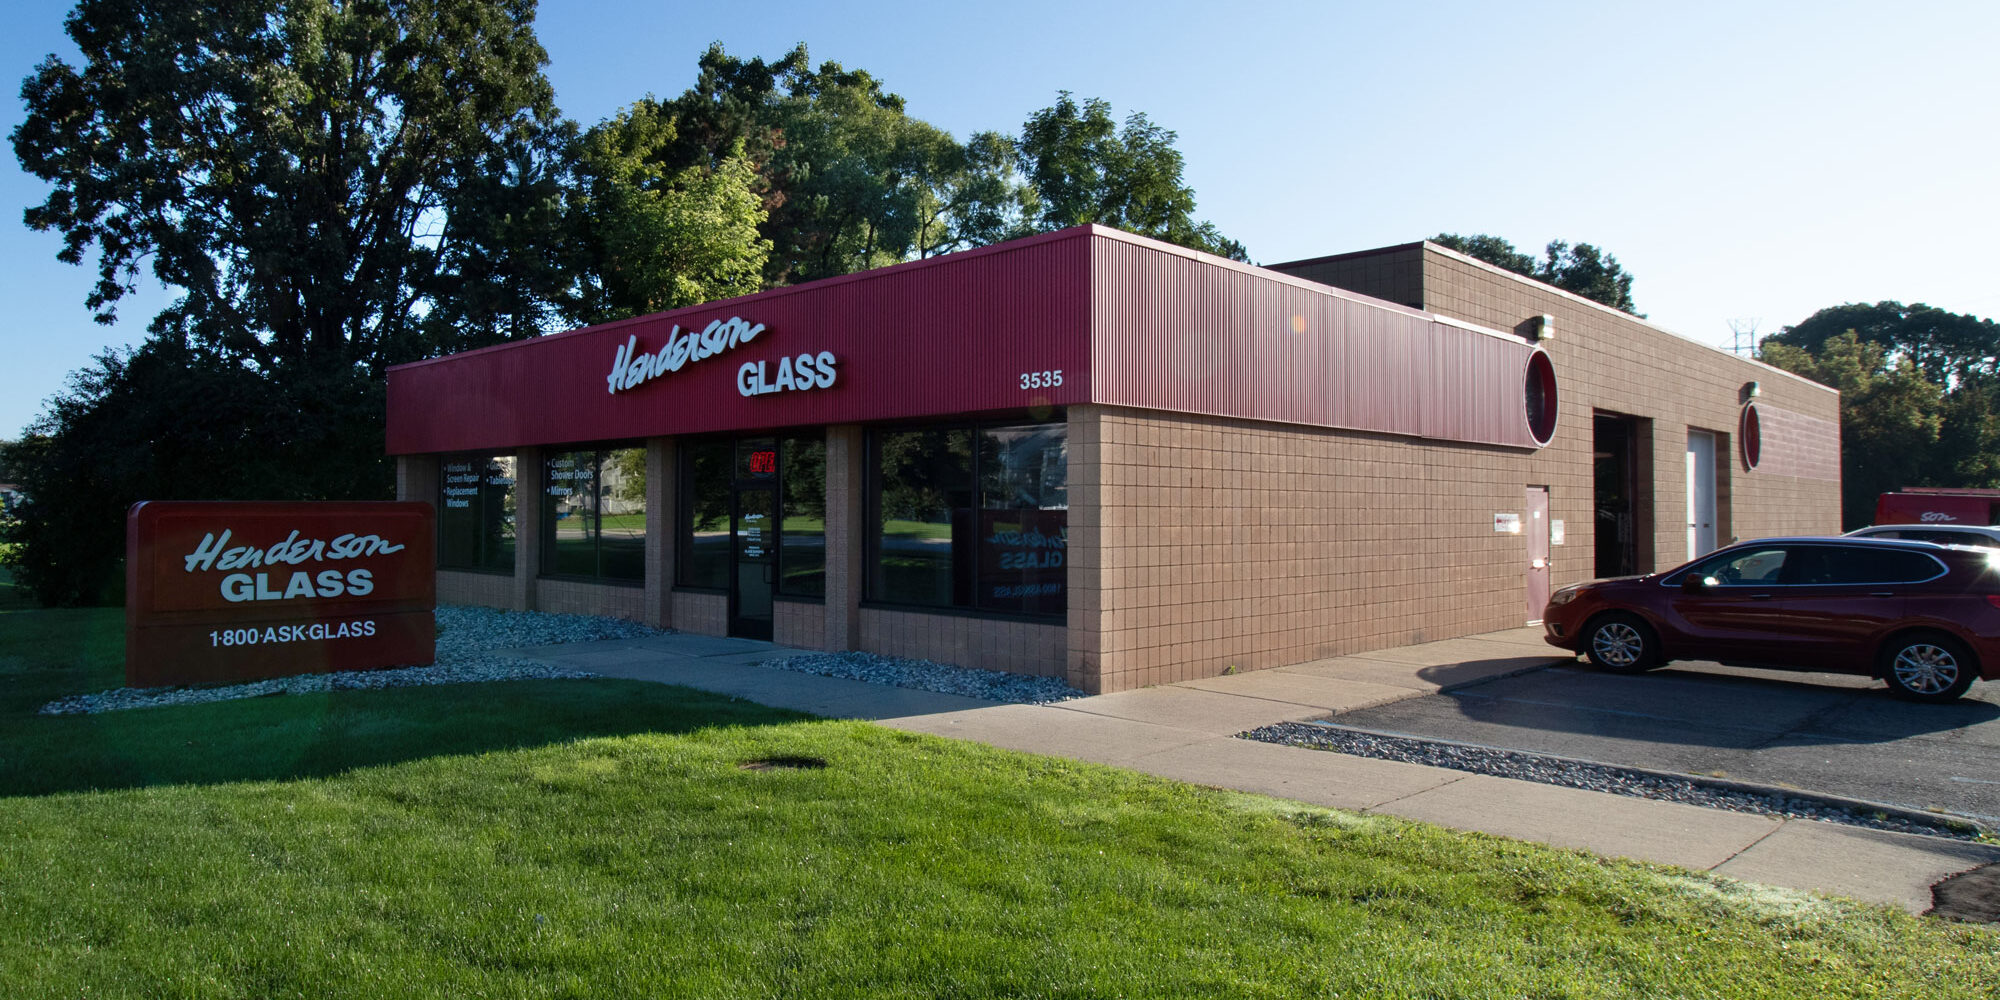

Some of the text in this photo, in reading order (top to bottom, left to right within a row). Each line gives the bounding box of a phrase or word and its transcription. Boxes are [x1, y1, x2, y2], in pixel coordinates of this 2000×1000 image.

[607, 316, 766, 395] Henderson
[737, 351, 837, 396] GLASS
[1019, 369, 1063, 390] 3535
[551, 458, 574, 468] Custom
[463, 473, 480, 484] Repair
[551, 469, 594, 480] Shower Doors
[446, 486, 478, 497] Replacement
[550, 485, 573, 496] Mirrors
[446, 498, 469, 508] Windows
[1920, 511, 1957, 522] son
[184, 528, 405, 573] Henderson
[220, 568, 374, 602] GLASS
